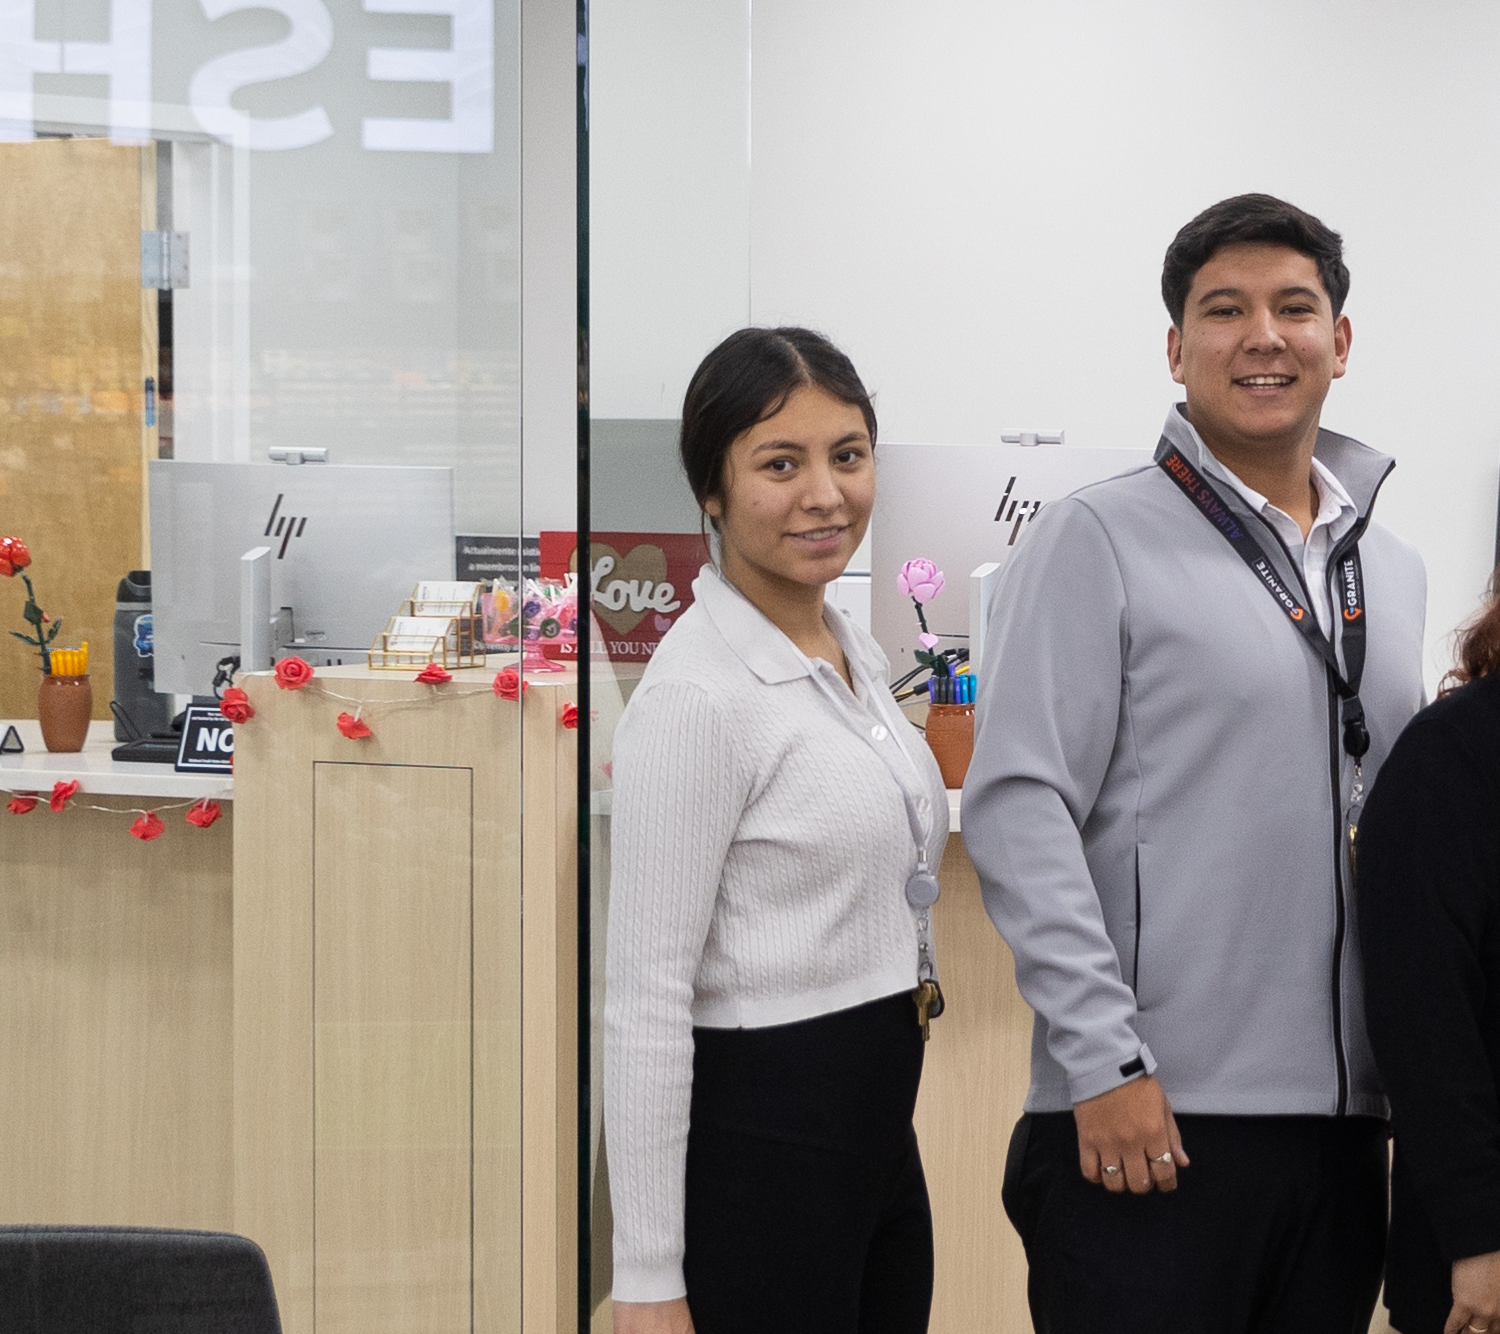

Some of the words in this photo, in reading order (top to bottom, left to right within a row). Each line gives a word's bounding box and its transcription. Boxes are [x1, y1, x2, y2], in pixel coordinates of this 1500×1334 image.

[1165, 453, 1201, 494] THERE
[1197, 489, 1243, 540] ALWAYS
[589, 555, 682, 613] Love
[1255, 560, 1294, 609] GRANITE
[1343, 559, 1358, 607] GRANITE
[609, 641, 640, 655] YOU
